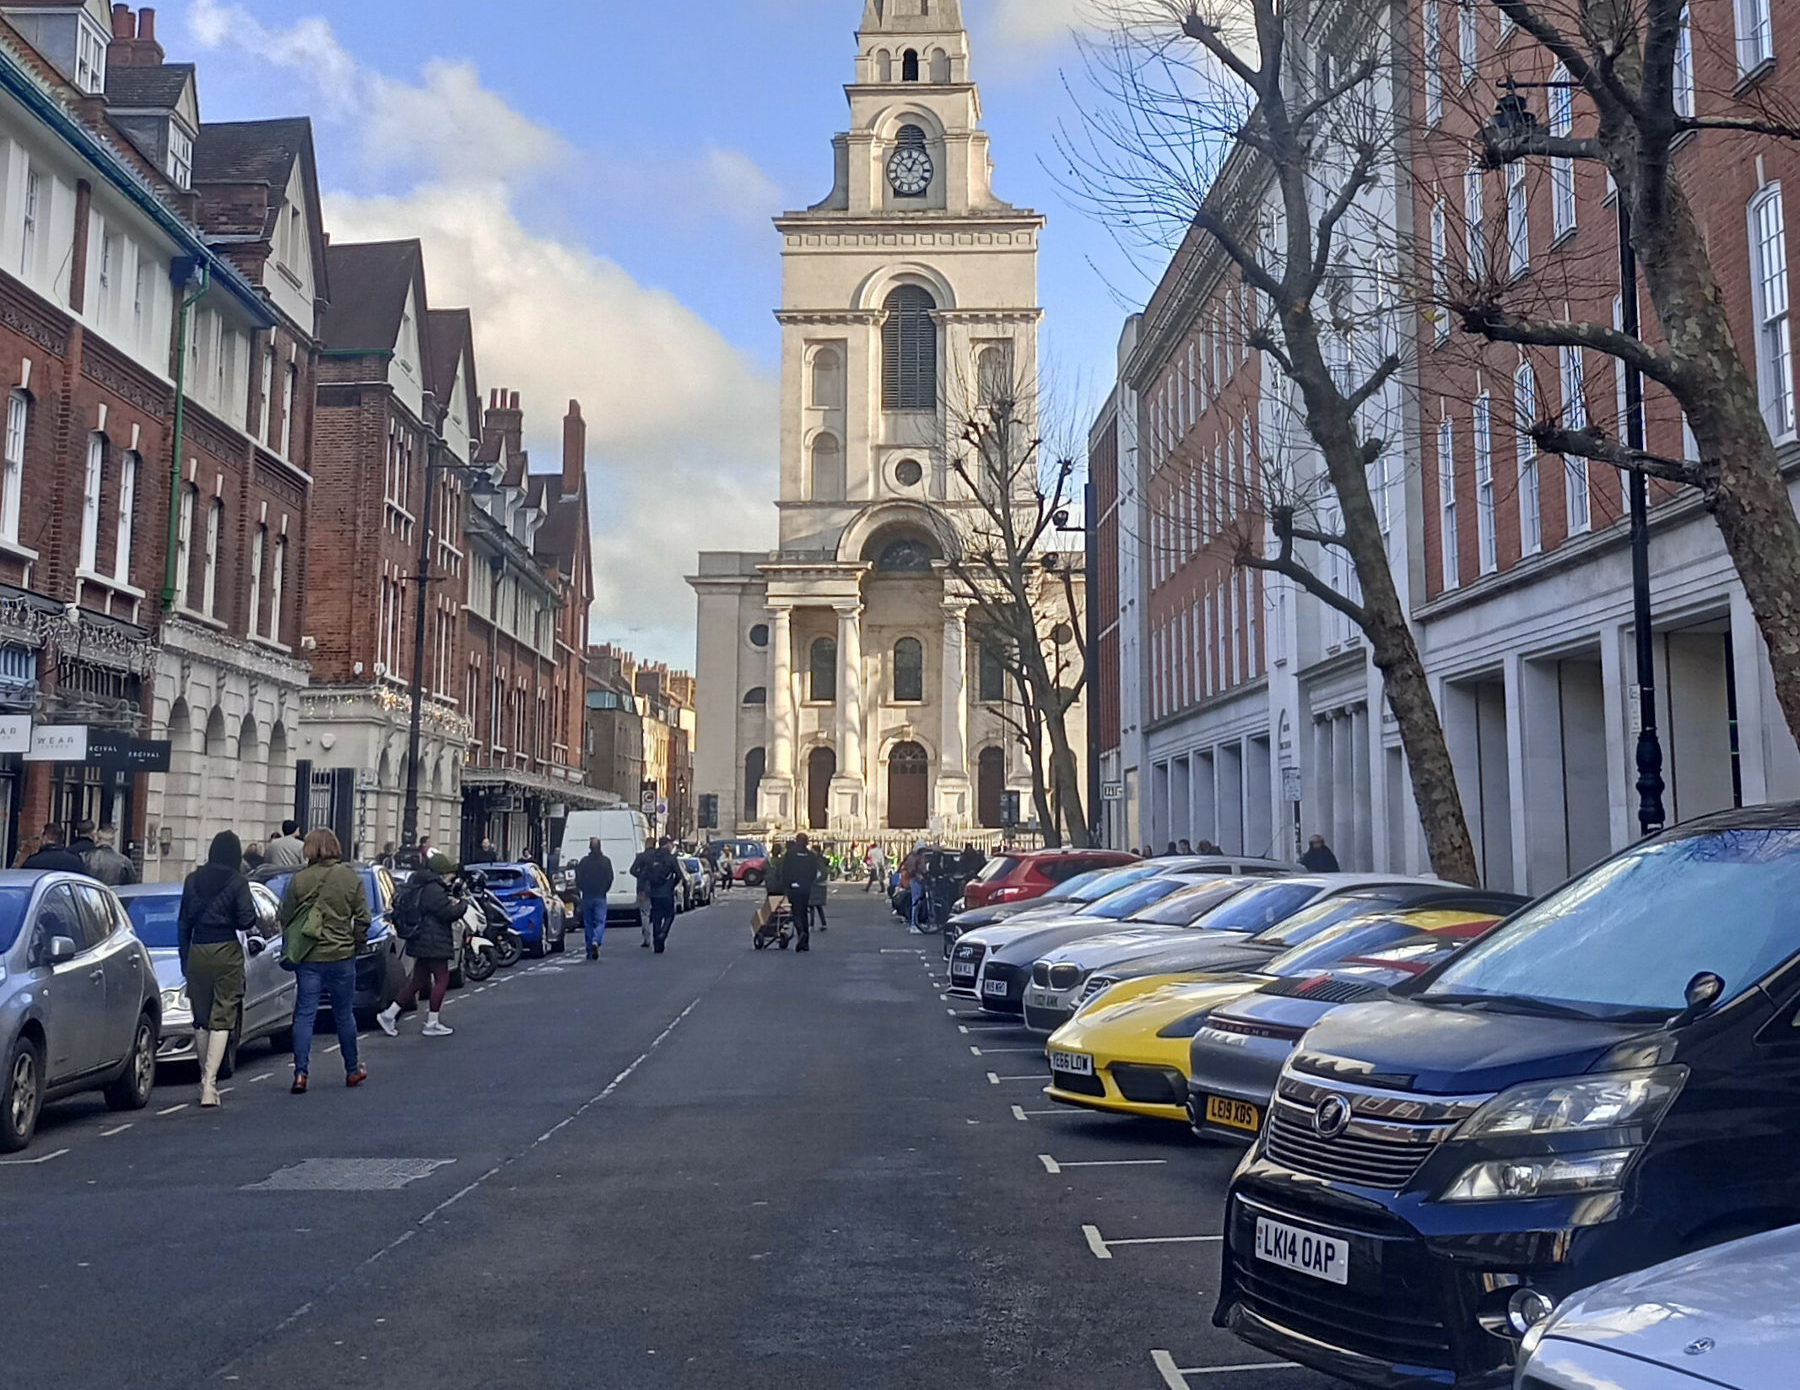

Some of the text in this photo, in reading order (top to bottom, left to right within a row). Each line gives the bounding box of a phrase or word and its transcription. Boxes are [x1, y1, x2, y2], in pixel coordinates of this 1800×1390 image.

[1211, 1098, 1233, 1121] LE19
[1264, 1224, 1335, 1273] LK14 OAP
